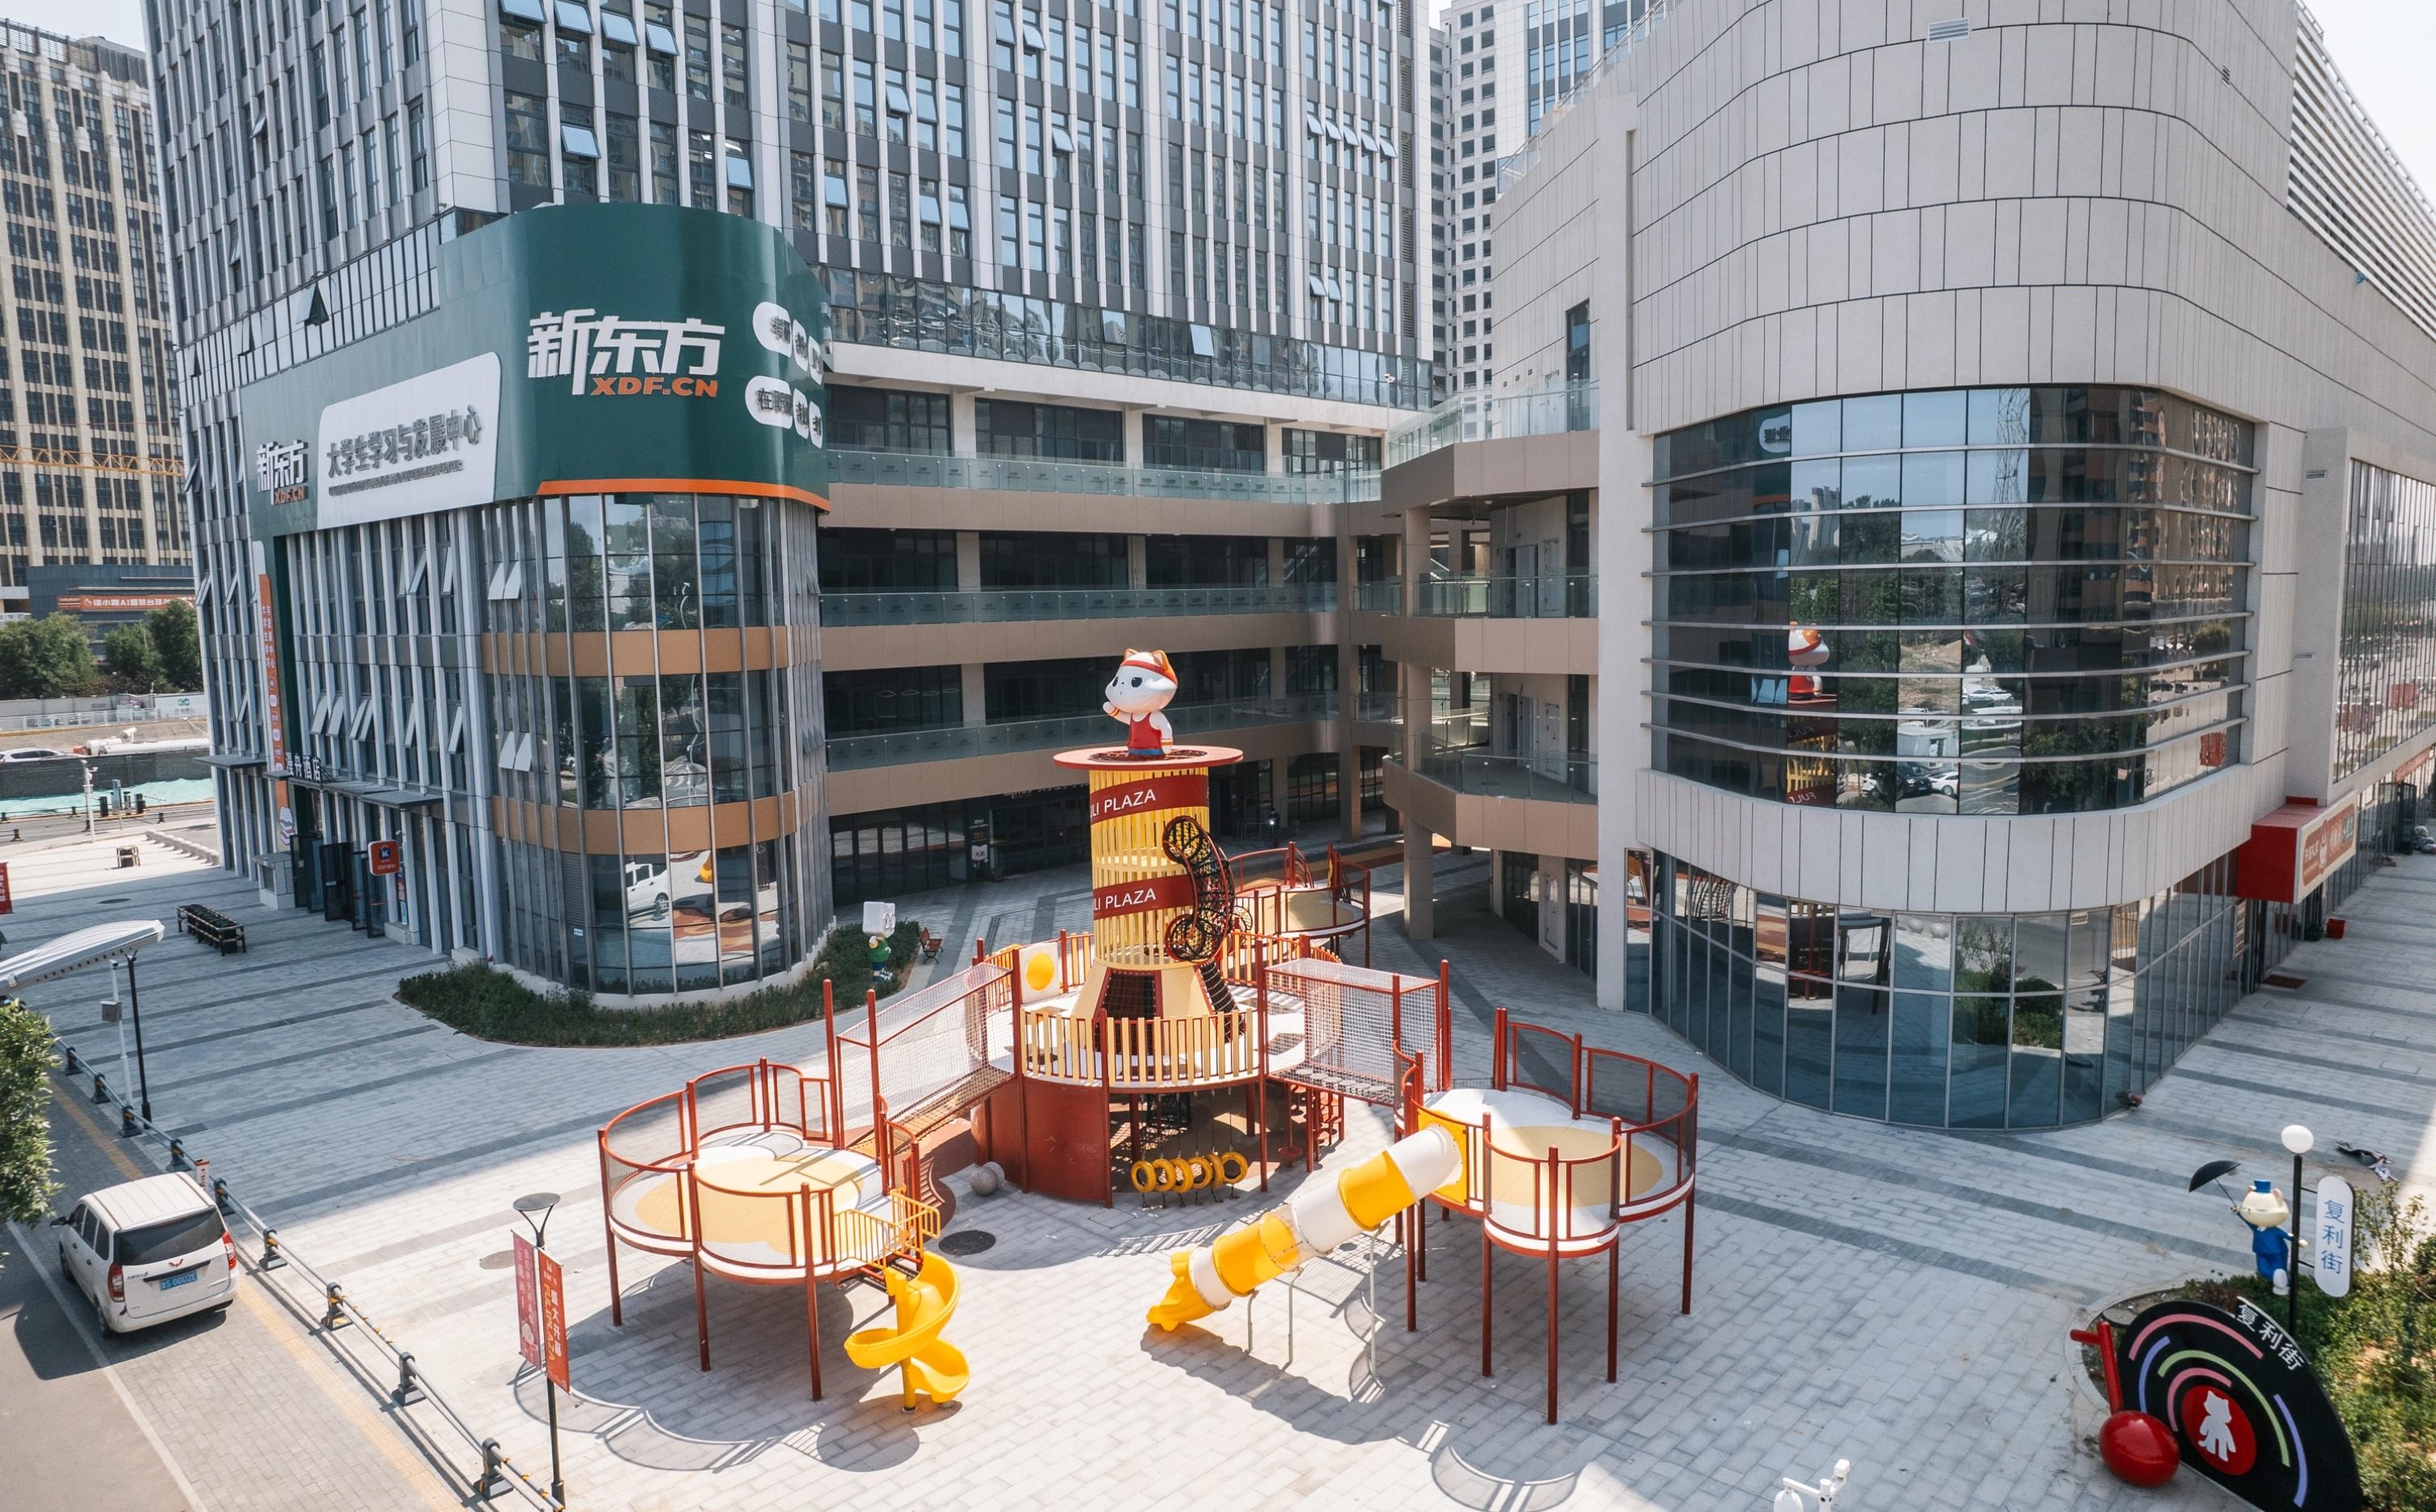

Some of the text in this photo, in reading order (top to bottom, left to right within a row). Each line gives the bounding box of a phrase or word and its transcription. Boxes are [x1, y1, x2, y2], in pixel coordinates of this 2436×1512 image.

[527, 308, 725, 395] 新东方
[590, 377, 717, 397] XDF.CN
[256, 439, 308, 505] 新东方
[326, 405, 482, 479] 大学生学习与发展中心
[274, 486, 306, 505] XDF.CN
[1104, 788, 1156, 813] PLAZA
[1105, 887, 1157, 909] PLAZA
[2321, 1199, 2346, 1274] 复利街
[551, 1289, 563, 1357] 盛大开幕
[2236, 1303, 2305, 1371] 复利街
